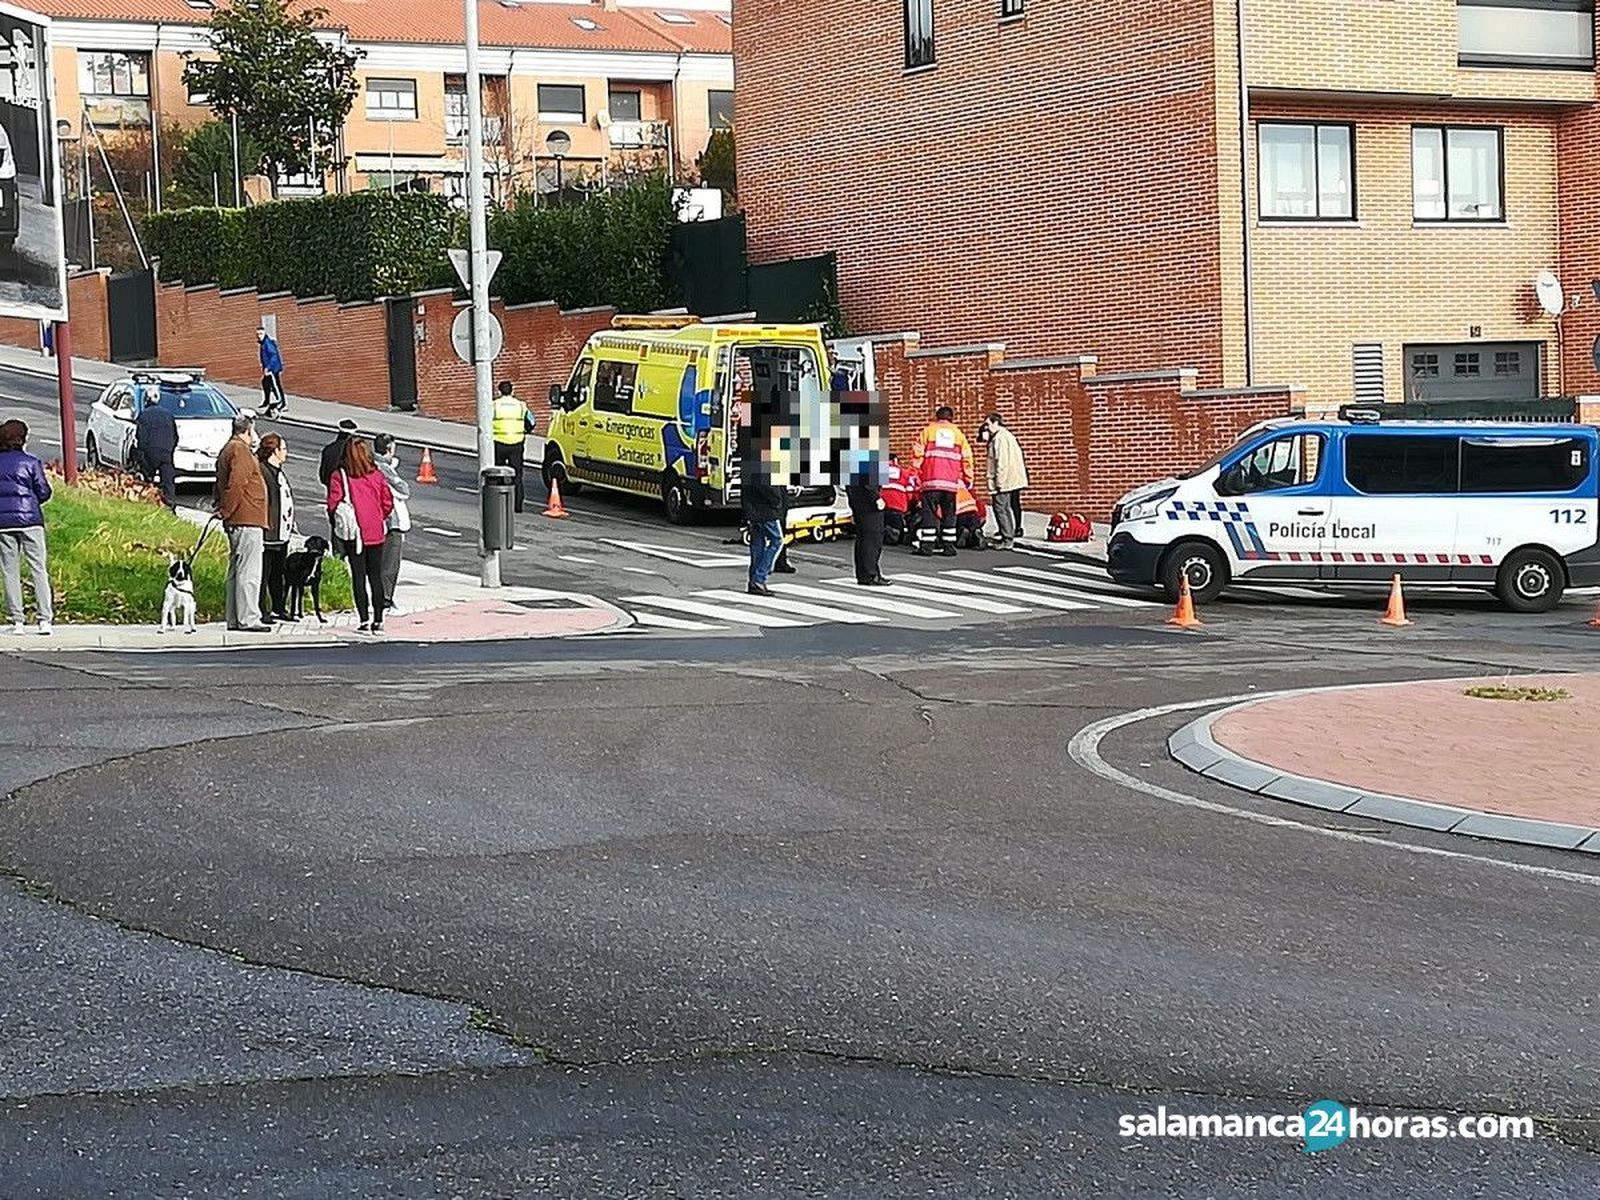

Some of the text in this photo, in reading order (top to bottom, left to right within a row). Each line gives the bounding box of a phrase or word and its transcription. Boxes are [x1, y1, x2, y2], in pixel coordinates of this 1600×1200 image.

[606, 417, 656, 440] Emergencias
[617, 444, 656, 466] Sanitarias
[1549, 508, 1588, 524] 112
[1269, 521, 1376, 539] Policía Local
